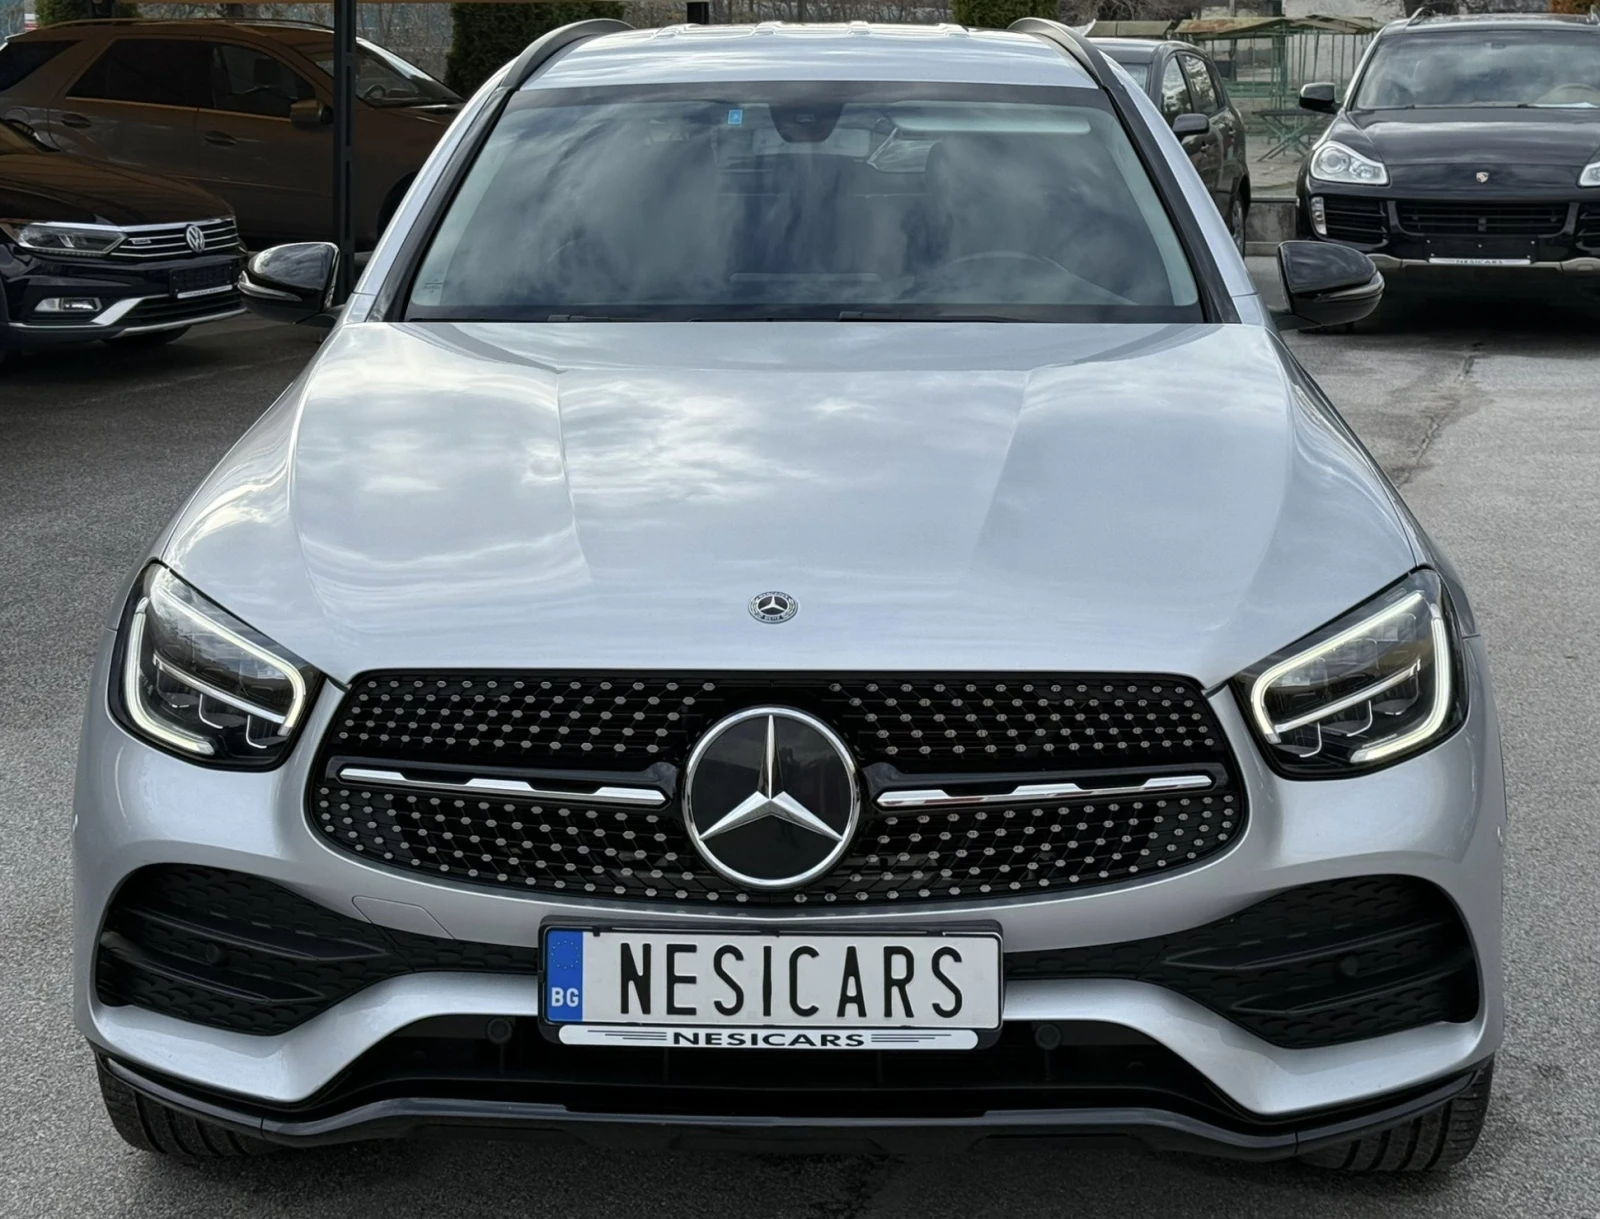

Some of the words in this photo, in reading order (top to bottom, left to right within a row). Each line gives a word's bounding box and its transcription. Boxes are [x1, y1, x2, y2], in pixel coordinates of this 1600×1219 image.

[620, 942, 963, 1019] NESICARS
[551, 986, 579, 1008] BG
[673, 1031, 865, 1047] NESICARS
